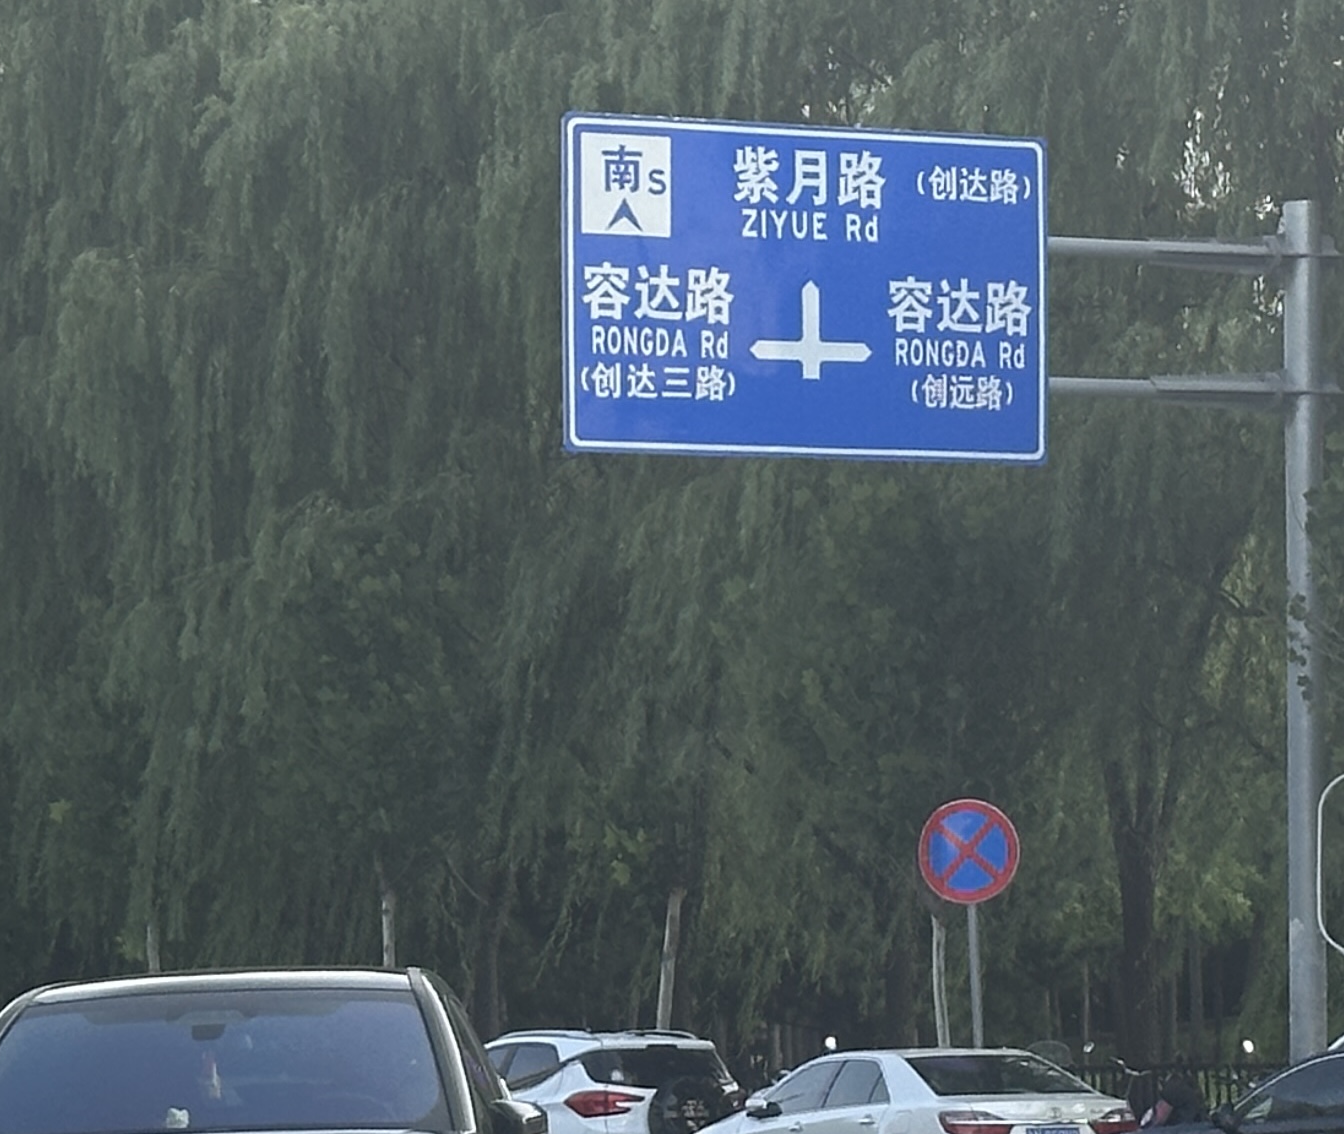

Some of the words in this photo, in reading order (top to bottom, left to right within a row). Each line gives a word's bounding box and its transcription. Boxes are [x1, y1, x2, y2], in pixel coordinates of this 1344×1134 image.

[732, 145, 887, 209] 紫月路
[916, 165, 1031, 205] (创达路)
[741, 208, 828, 241] ZIYUE
[845, 213, 879, 243] Rd
[581, 261, 735, 326] 容达路
[887, 275, 1032, 337] 容达路
[591, 324, 688, 358] RONGDA
[700, 328, 729, 360] Rd
[895, 337, 986, 369] RONGDA
[999, 340, 1025, 370] Rd
[580, 361, 737, 402] (创达三路)
[911, 373, 1014, 411] (创远路)
